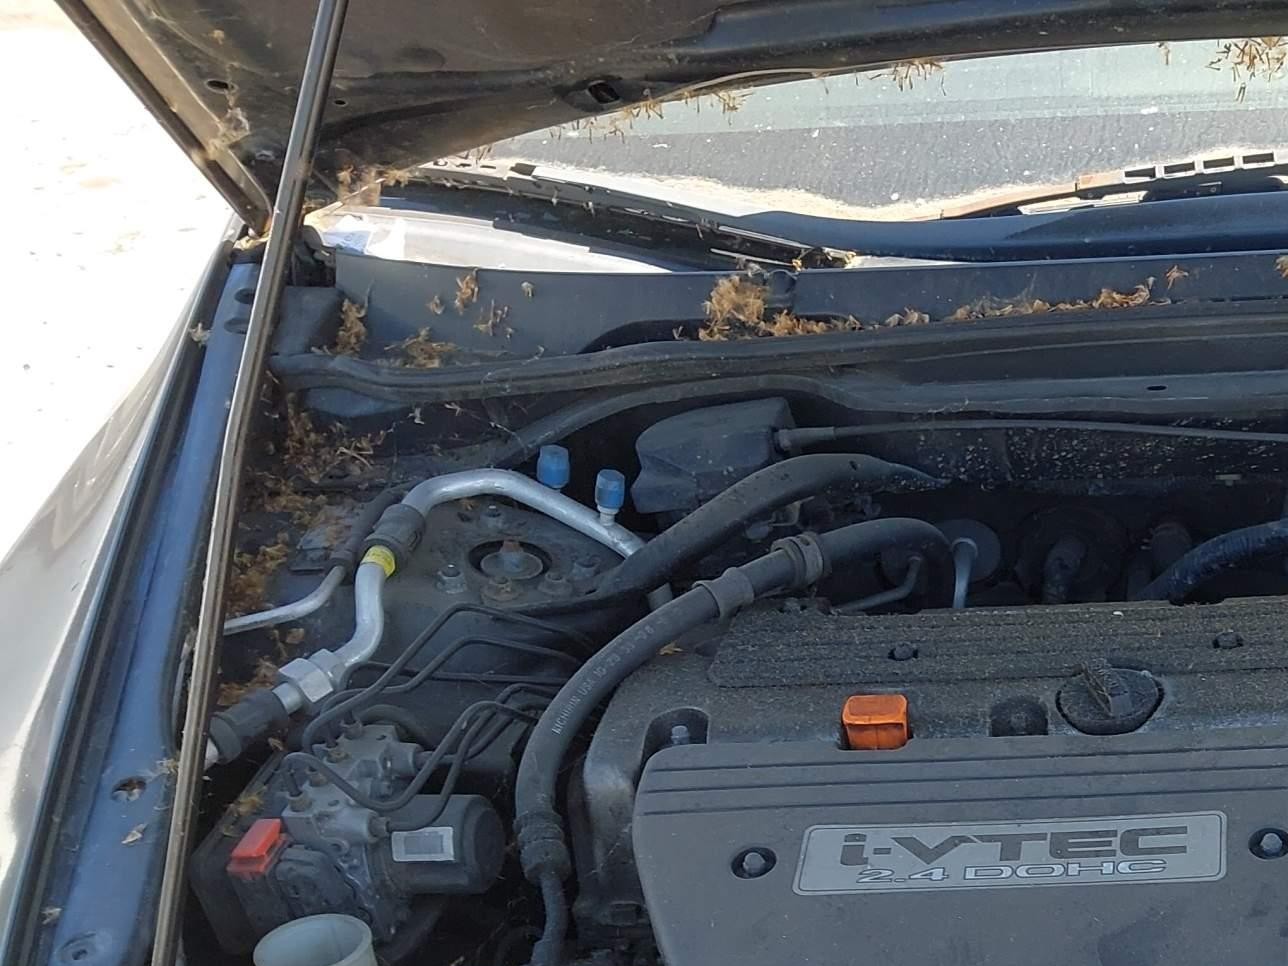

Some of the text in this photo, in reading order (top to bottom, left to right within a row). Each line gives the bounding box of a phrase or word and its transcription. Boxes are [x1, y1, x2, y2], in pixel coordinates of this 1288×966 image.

[839, 825, 1189, 866] i-VTEC
[856, 859, 1168, 884] 2.4 DOHC
